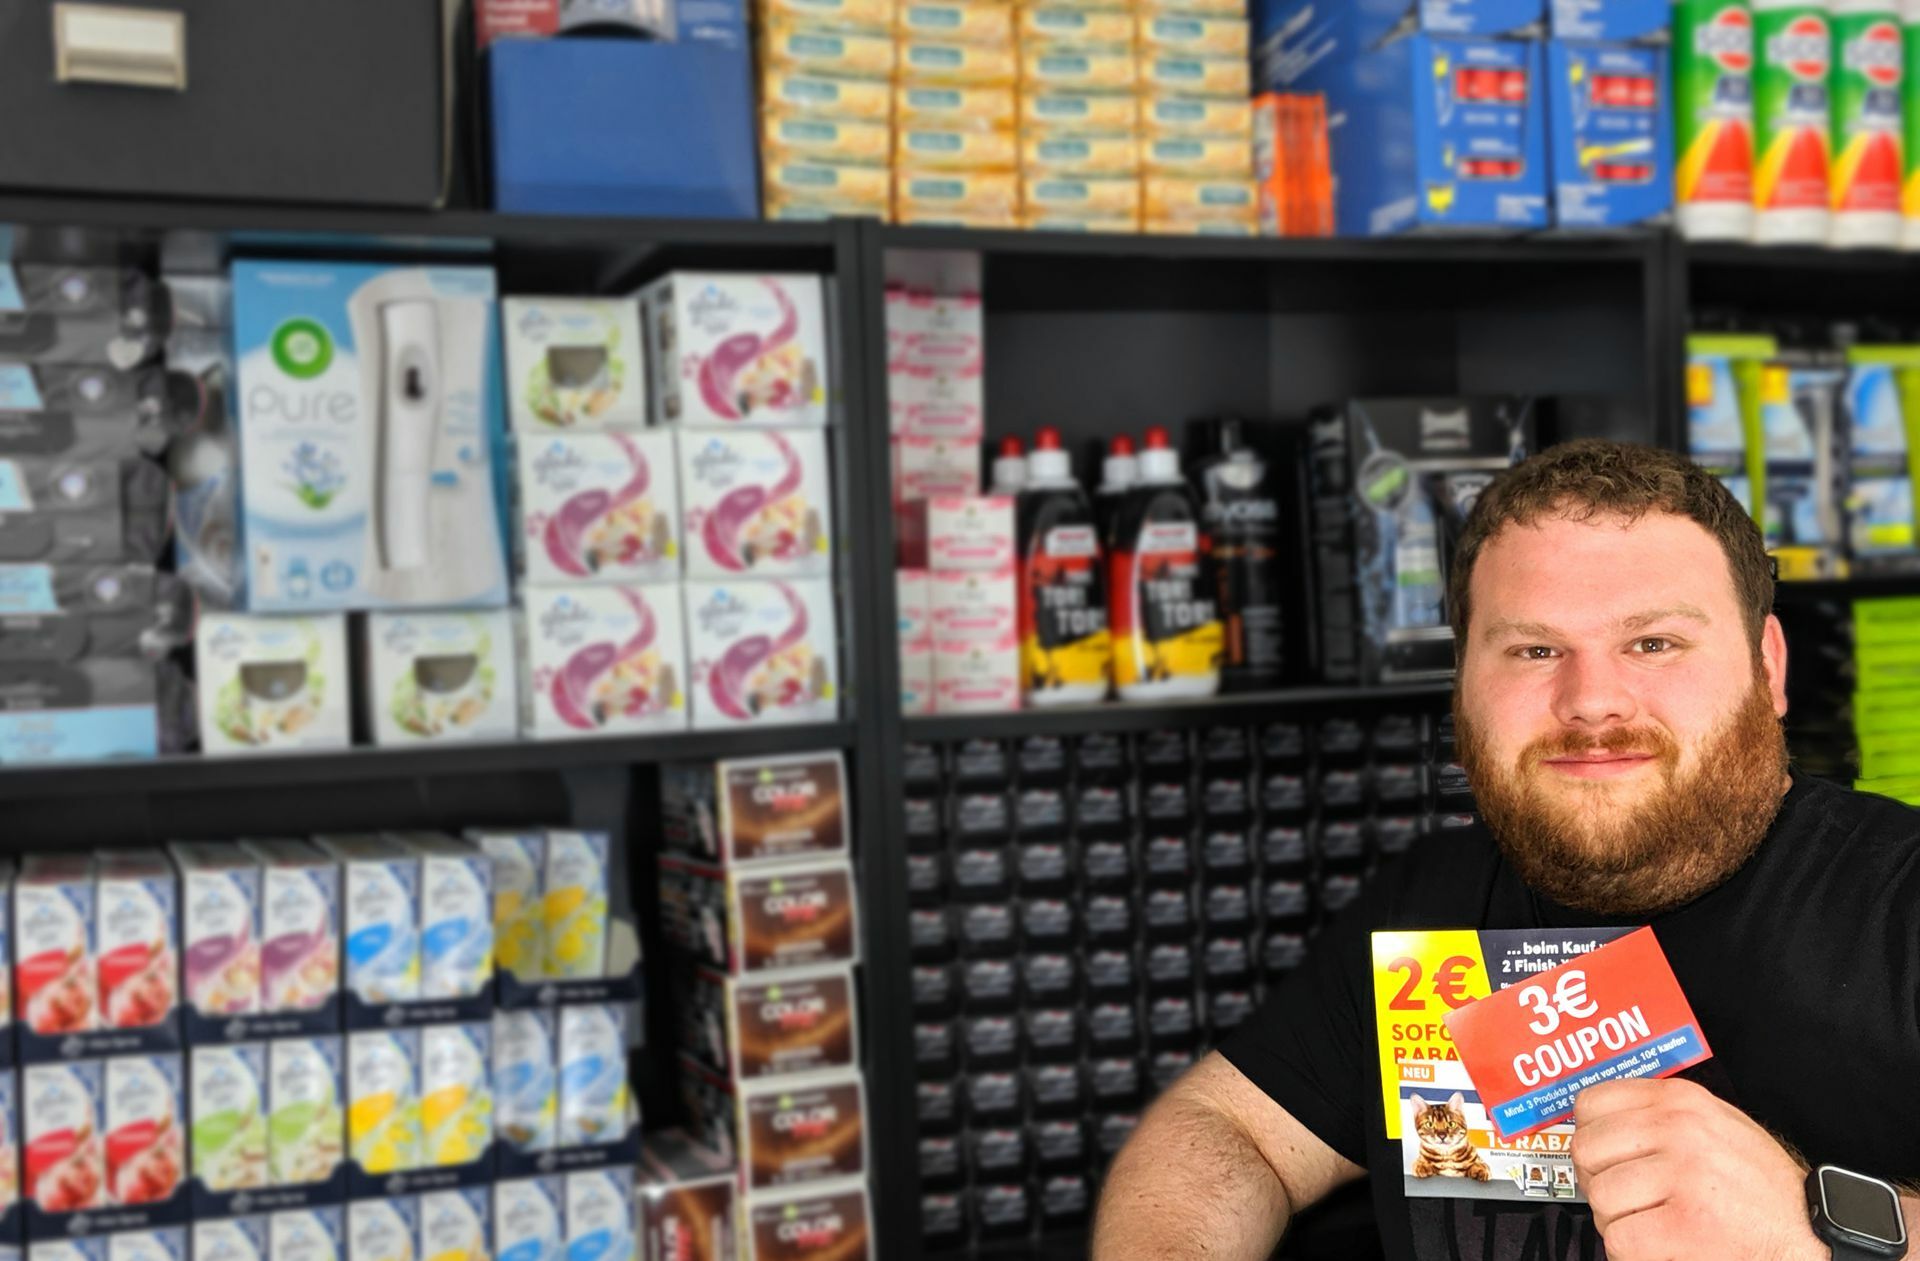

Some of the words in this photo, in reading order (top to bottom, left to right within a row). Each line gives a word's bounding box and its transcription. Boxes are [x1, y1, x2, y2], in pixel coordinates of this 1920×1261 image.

[249, 385, 357, 423] Pure
[1562, 941, 1596, 954] Kauf
[1502, 960, 1511, 973] 2
[1515, 959, 1557, 972] Finish
[1518, 970, 1599, 1035] 3€
[1513, 1005, 1651, 1087] COUPON
[1403, 1067, 1430, 1079] NEU
[1503, 1103, 1527, 1118] Mind.
[1526, 1099, 1534, 1109] 3
[1533, 1086, 1568, 1106] Produkte
[1567, 1082, 1580, 1093] im
[1580, 1071, 1600, 1087] Wert
[1600, 1066, 1616, 1078] von
[1617, 1055, 1640, 1071] mind.
[1640, 1047, 1657, 1061] 10€
[1657, 1036, 1687, 1054] kaufen
[1624, 1059, 1661, 1079] erhalten!
[1541, 1103, 1556, 1116] und
[1556, 1098, 1569, 1109] 3€
